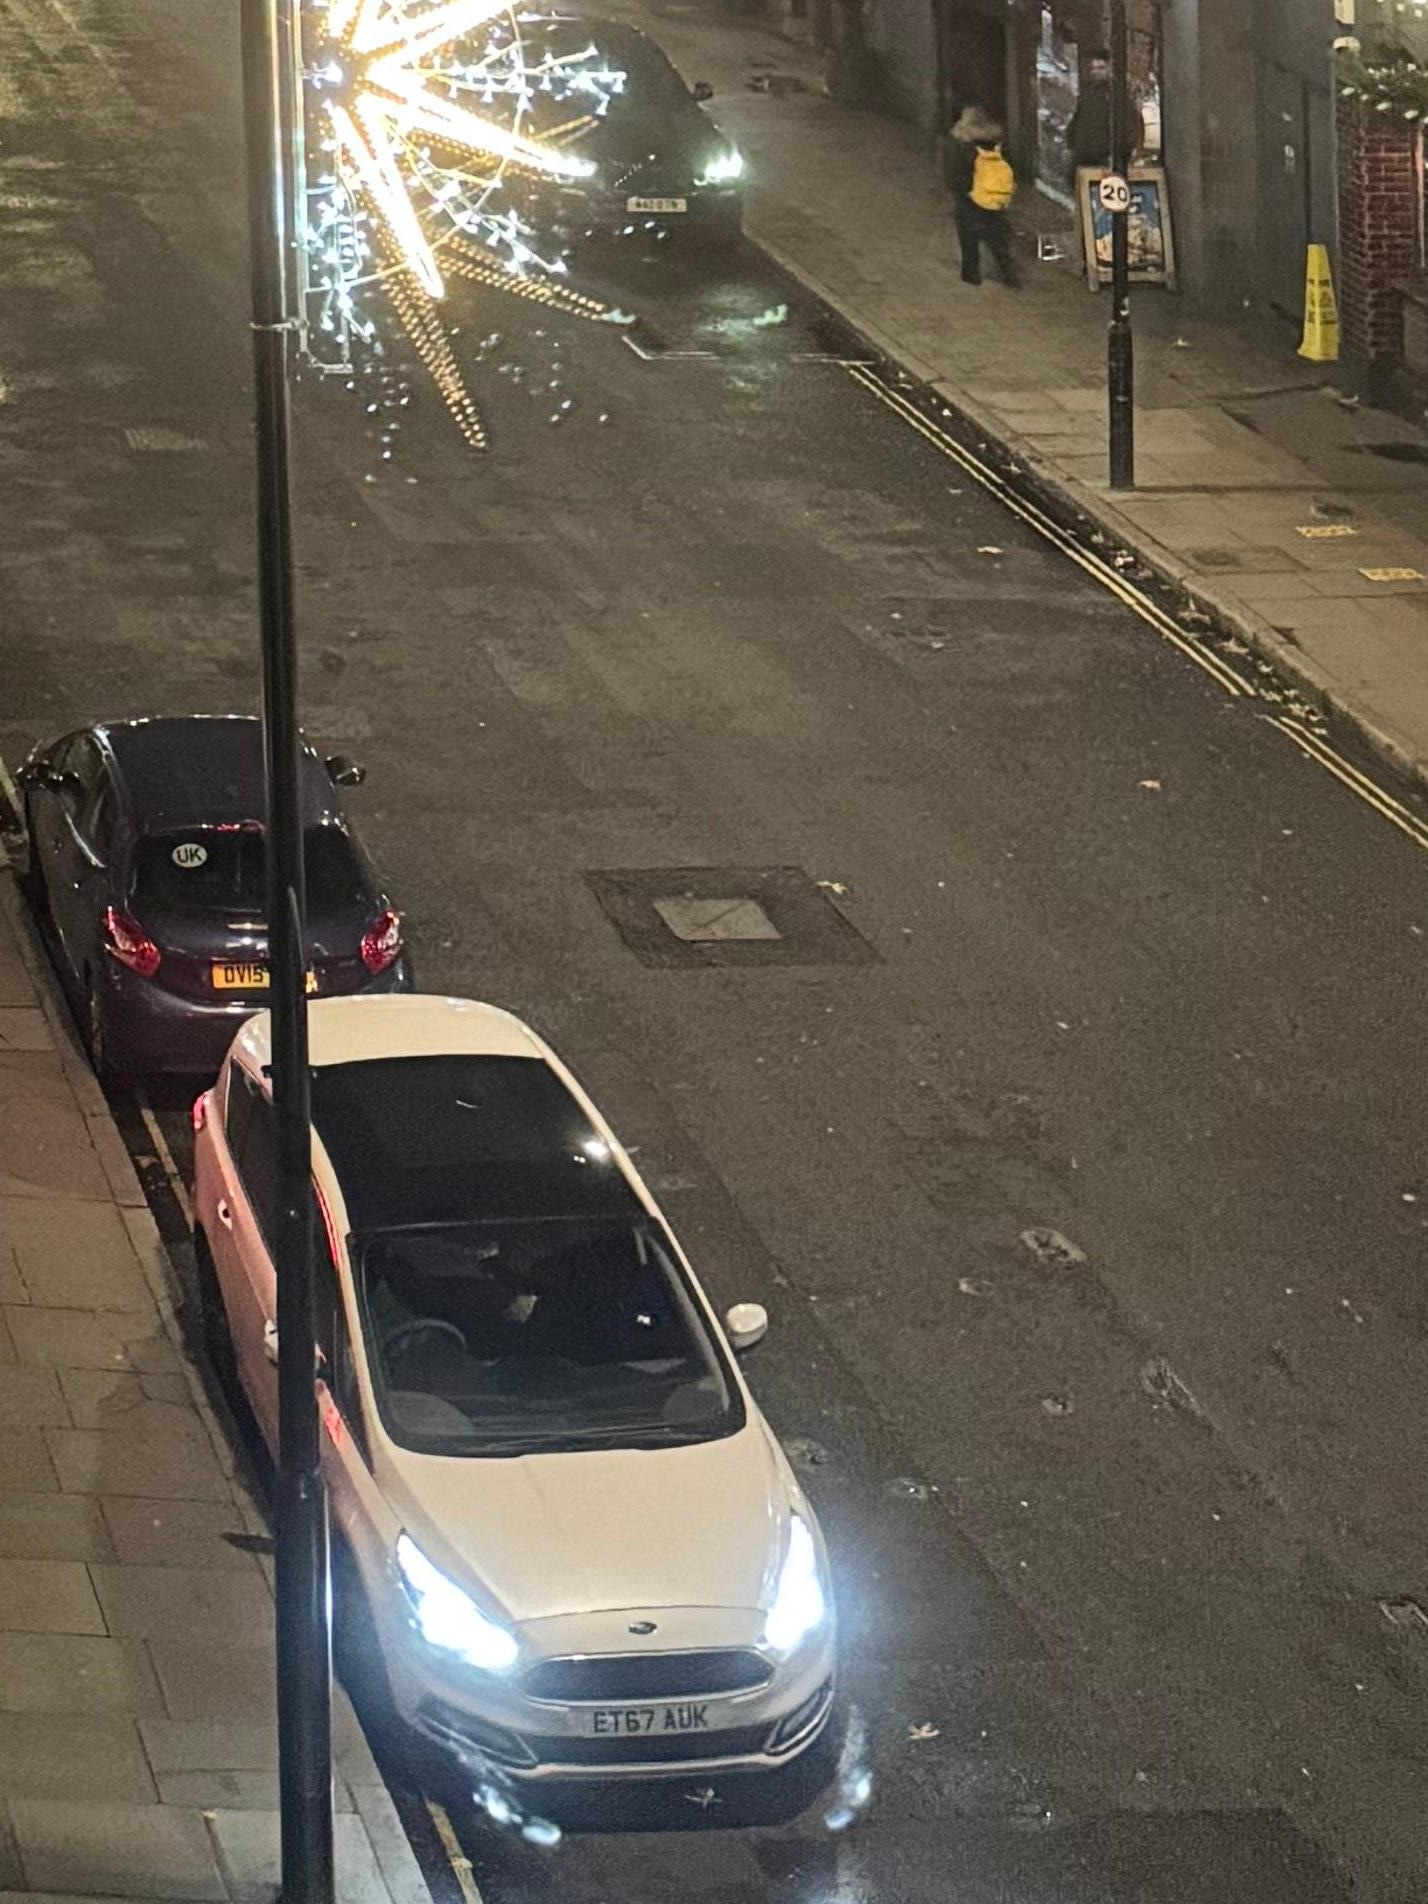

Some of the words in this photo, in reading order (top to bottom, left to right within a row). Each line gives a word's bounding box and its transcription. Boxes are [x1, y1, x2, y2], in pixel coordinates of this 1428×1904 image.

[1103, 184, 1127, 202] 20
[176, 847, 203, 864] UK
[593, 1709, 655, 1733] ET67
[664, 1705, 708, 1729] AUK
